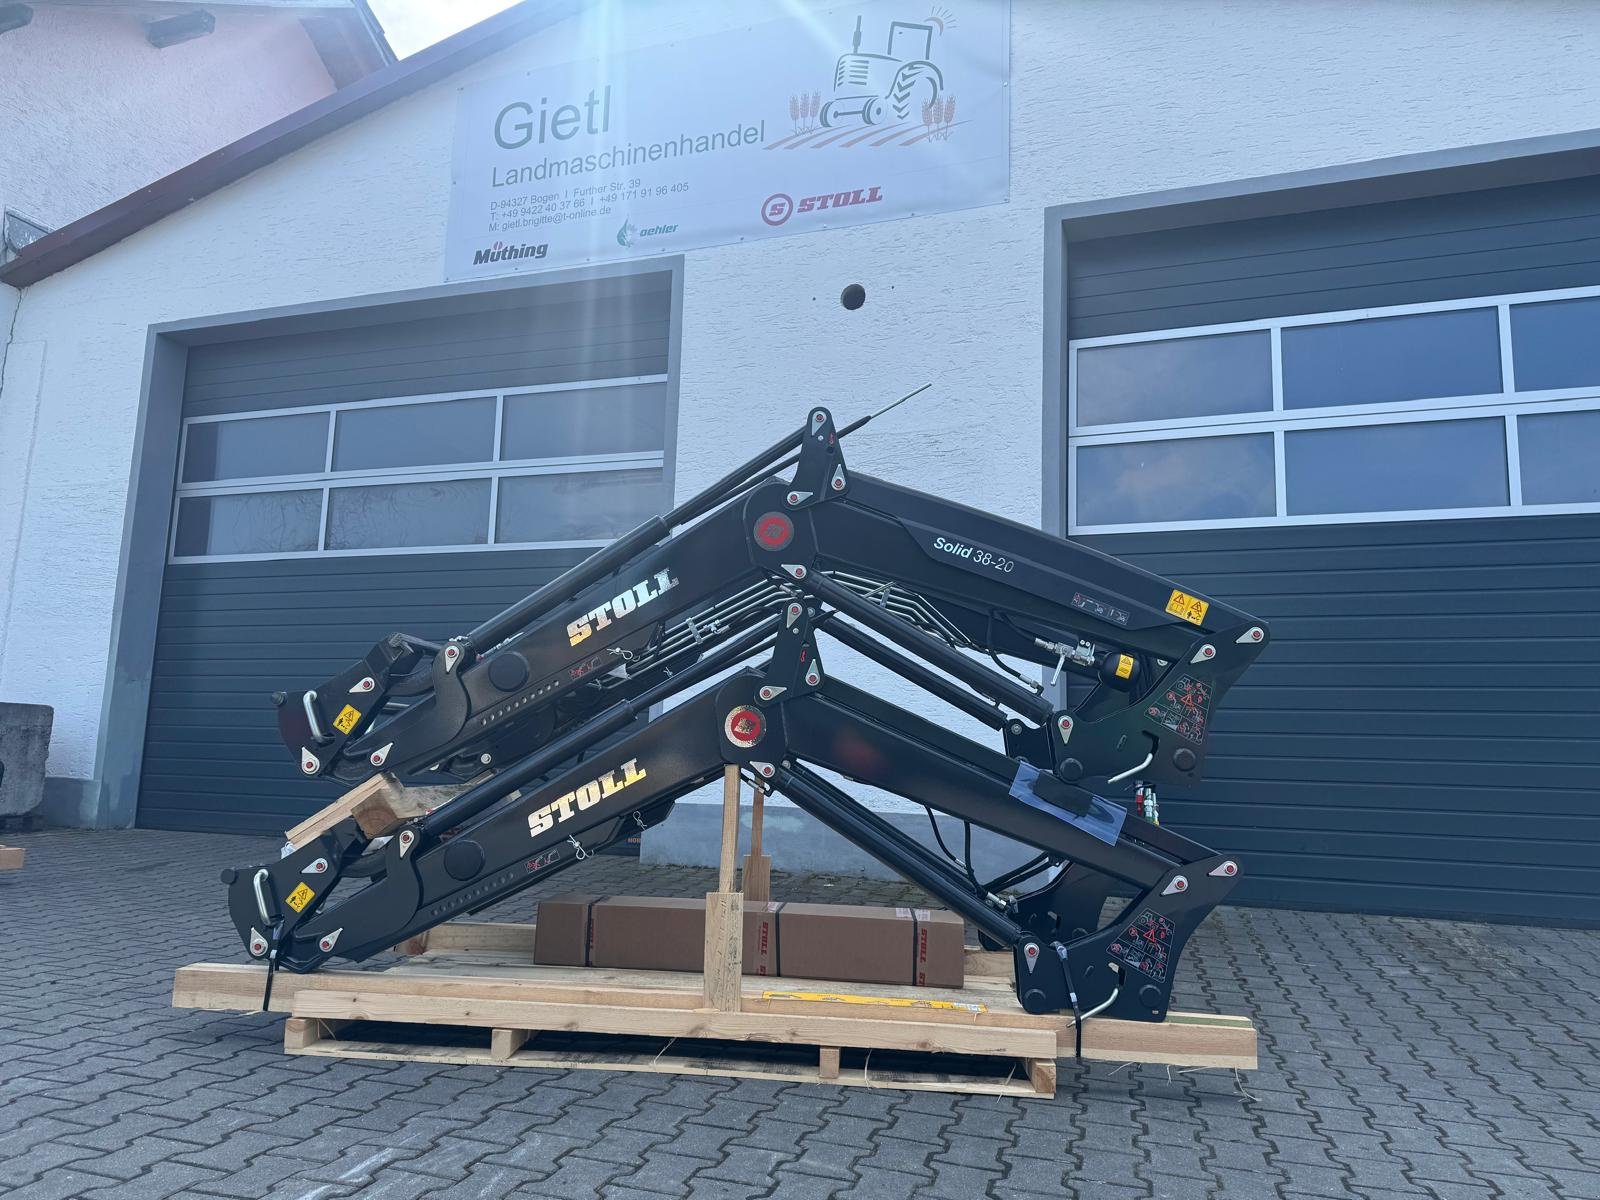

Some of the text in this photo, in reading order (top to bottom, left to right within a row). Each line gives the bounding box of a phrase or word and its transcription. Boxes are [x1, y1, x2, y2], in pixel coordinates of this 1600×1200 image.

[494, 85, 612, 150] Gietl
[492, 119, 765, 187] Landmaschinenhandel
[490, 196, 528, 211] D-94327
[530, 192, 560, 206] Bogen
[610, 181, 626, 192] Str.
[629, 178, 641, 189] 39
[490, 211, 499, 221] T:
[502, 208, 518, 219] +49
[520, 204, 544, 216] 9422
[545, 202, 557, 213] 40
[560, 200, 572, 211] 37
[573, 199, 585, 209] 66
[600, 193, 617, 204] +49
[622, 190, 637, 201] 171
[640, 188, 652, 199] 91
[656, 185, 668, 196] 96
[671, 182, 689, 194] 405
[797, 186, 883, 213] STOLL
[639, 224, 679, 238] oehler
[473, 241, 549, 265] Müthing
[933, 537, 1015, 573] Solid 38-20
[566, 567, 680, 647] STOLL
[527, 757, 647, 838] STOLL
